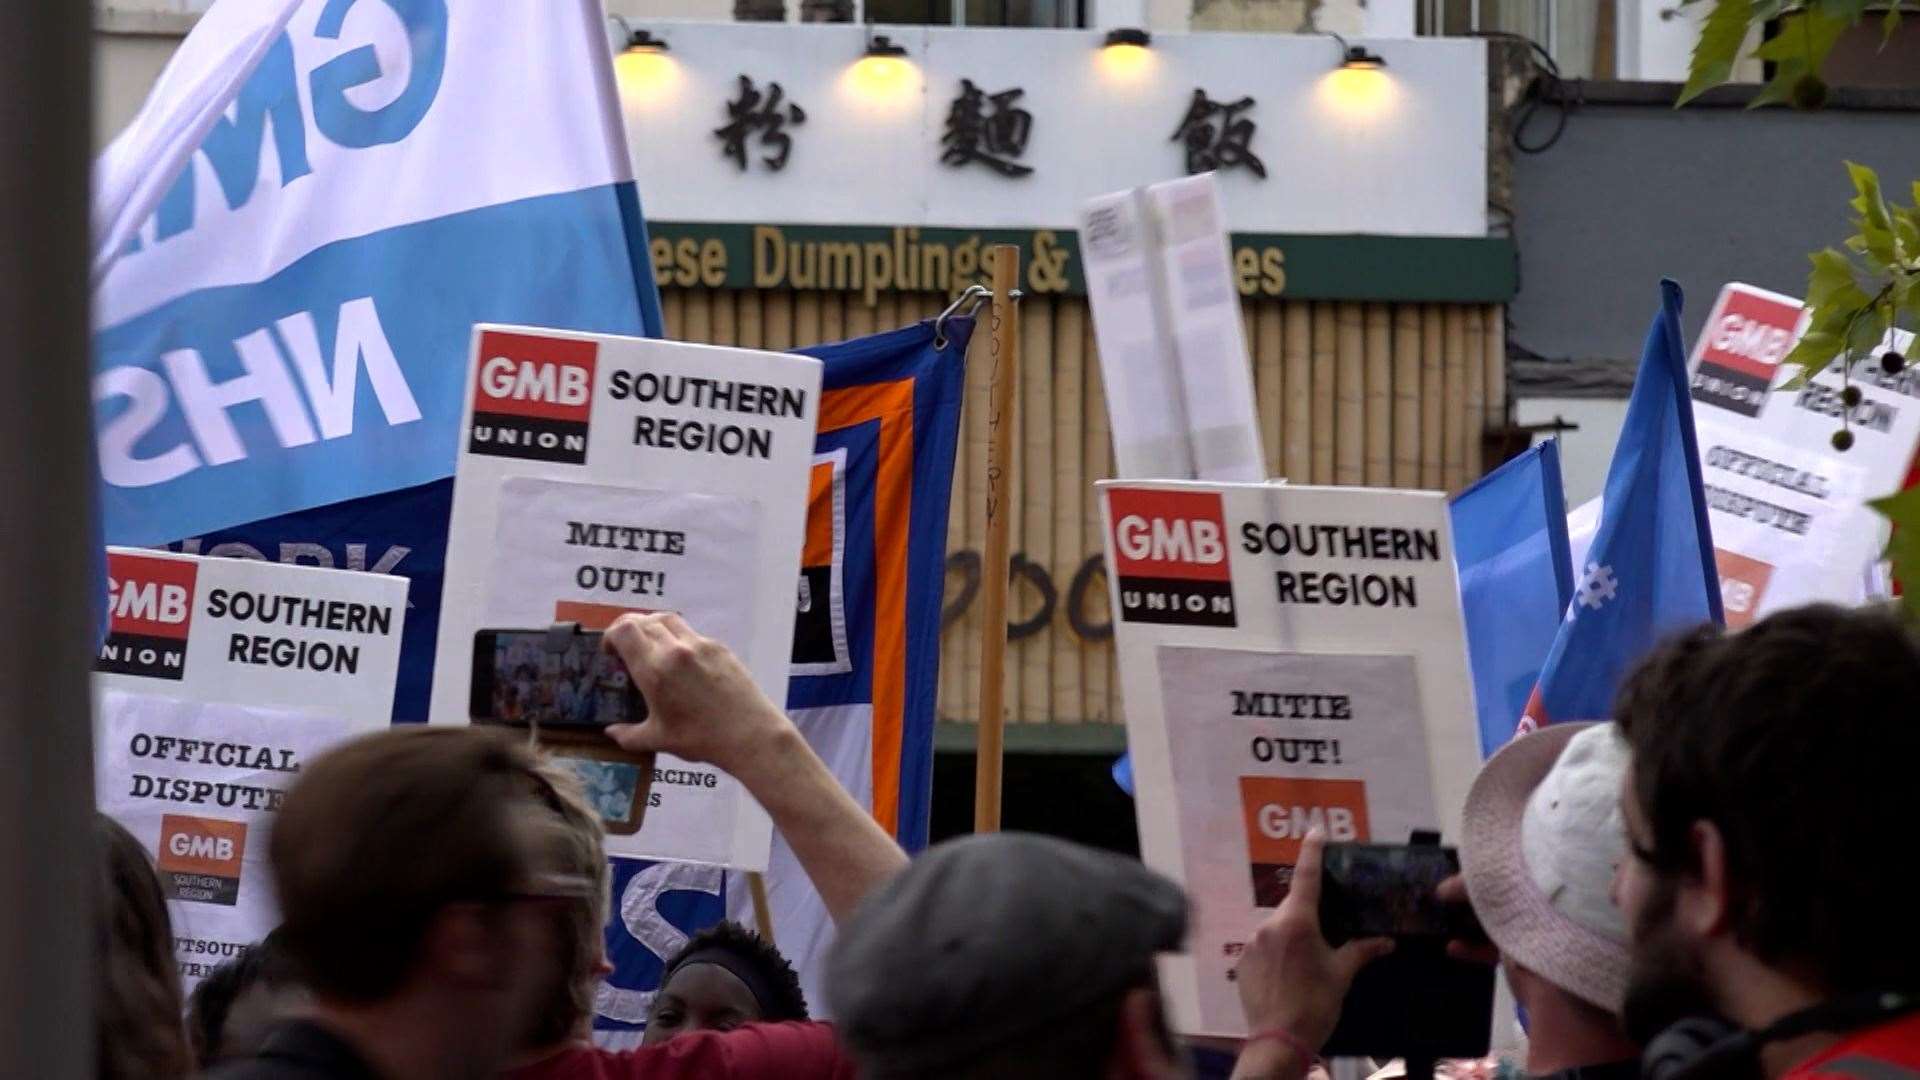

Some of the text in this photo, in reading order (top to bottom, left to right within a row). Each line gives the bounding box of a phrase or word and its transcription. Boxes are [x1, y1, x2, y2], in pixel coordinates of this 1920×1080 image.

[1027, 230, 1071, 293] &
[480, 356, 590, 406] GMB
[609, 369, 805, 419] SOUTHERN
[473, 424, 586, 452] UNION
[632, 416, 772, 458] REGION
[565, 521, 685, 555] MITIE
[1116, 514, 1224, 565] GMB
[1242, 522, 1440, 562] SOUTHERN
[576, 565, 665, 596] OUT!
[1276, 571, 1417, 608] REGION
[207, 588, 392, 636] SOUTHERN
[1122, 590, 1231, 614] UNION
[100, 644, 182, 668] NION
[228, 633, 360, 675] REGION
[1231, 690, 1352, 721] MITIE
[130, 733, 299, 772] OFFICIAL
[1252, 736, 1342, 765] OUT!
[1258, 802, 1357, 842] GMB
[169, 832, 234, 861] GMB
